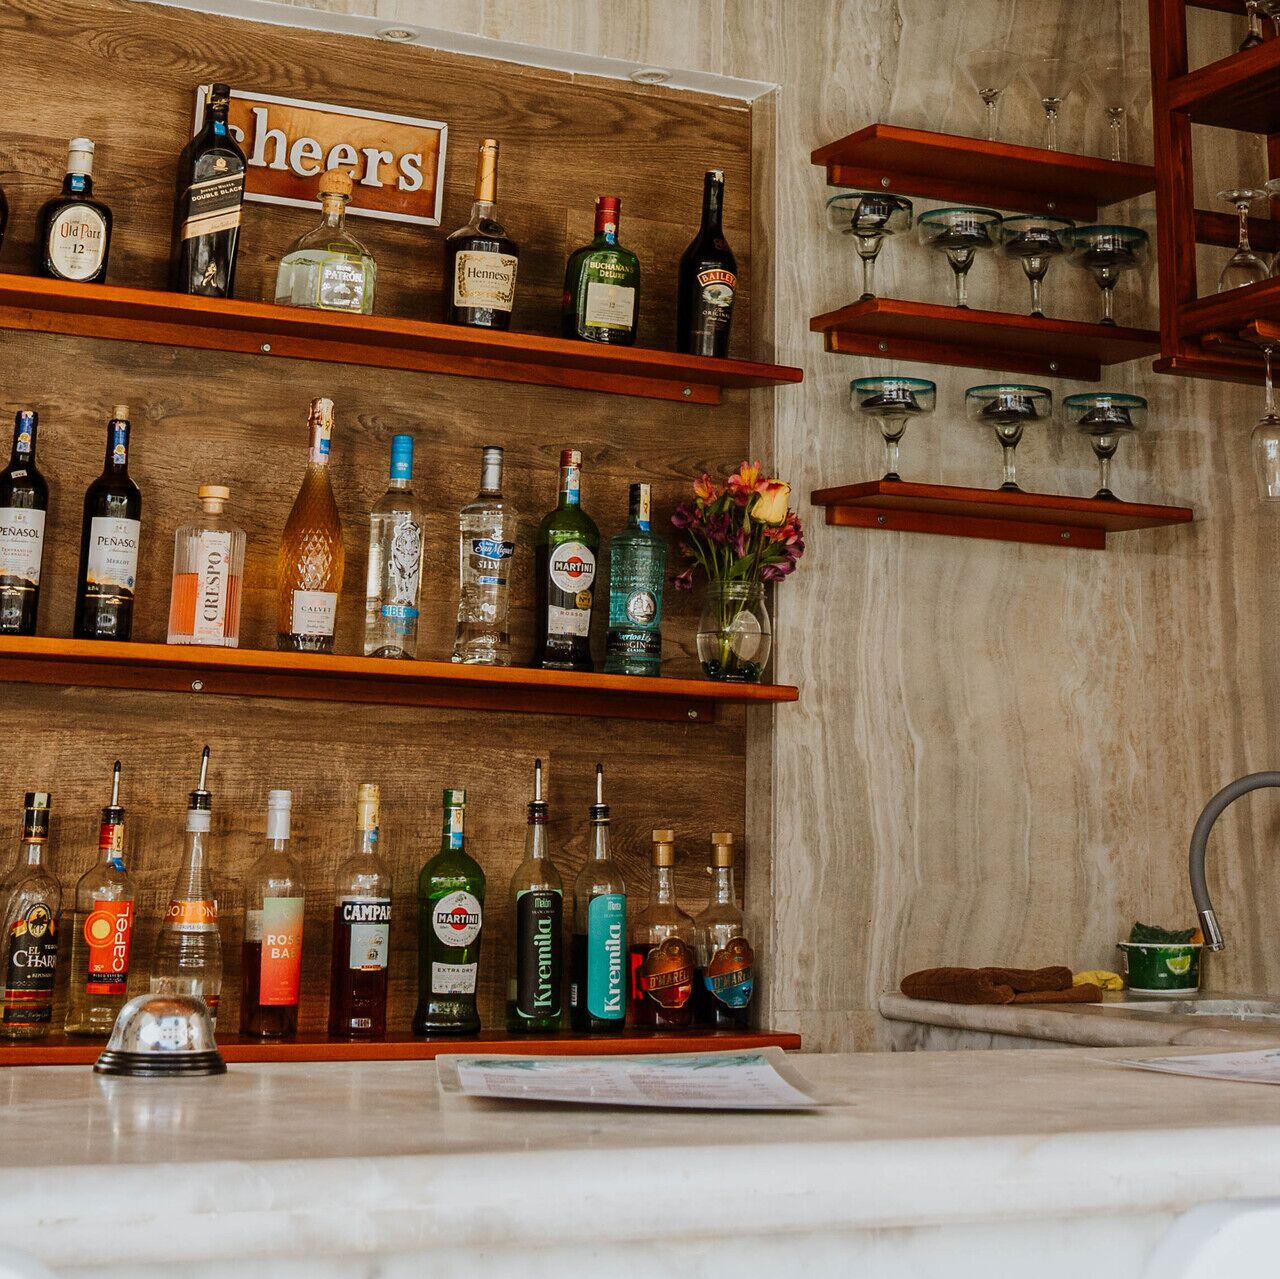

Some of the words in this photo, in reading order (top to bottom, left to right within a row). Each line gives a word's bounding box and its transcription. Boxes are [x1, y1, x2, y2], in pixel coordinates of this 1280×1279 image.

[191, 191, 219, 202] DOUBLE
[220, 185, 243, 195] BLACK
[61, 221, 79, 238] Old
[72, 243, 85, 254] 12
[467, 267, 510, 284] Hennessy
[701, 272, 736, 284] BAILEY
[555, 562, 593, 574] MARTINI
[203, 552, 222, 622] CRESPO
[560, 610, 583, 618] ROSSO
[629, 640, 646, 649] GIN
[343, 904, 392, 921] CAMPAR
[438, 913, 478, 924] MARTINI
[28, 946, 41, 955] EL
[533, 916, 552, 1008] Kremila
[604, 921, 621, 1012] Kremila
